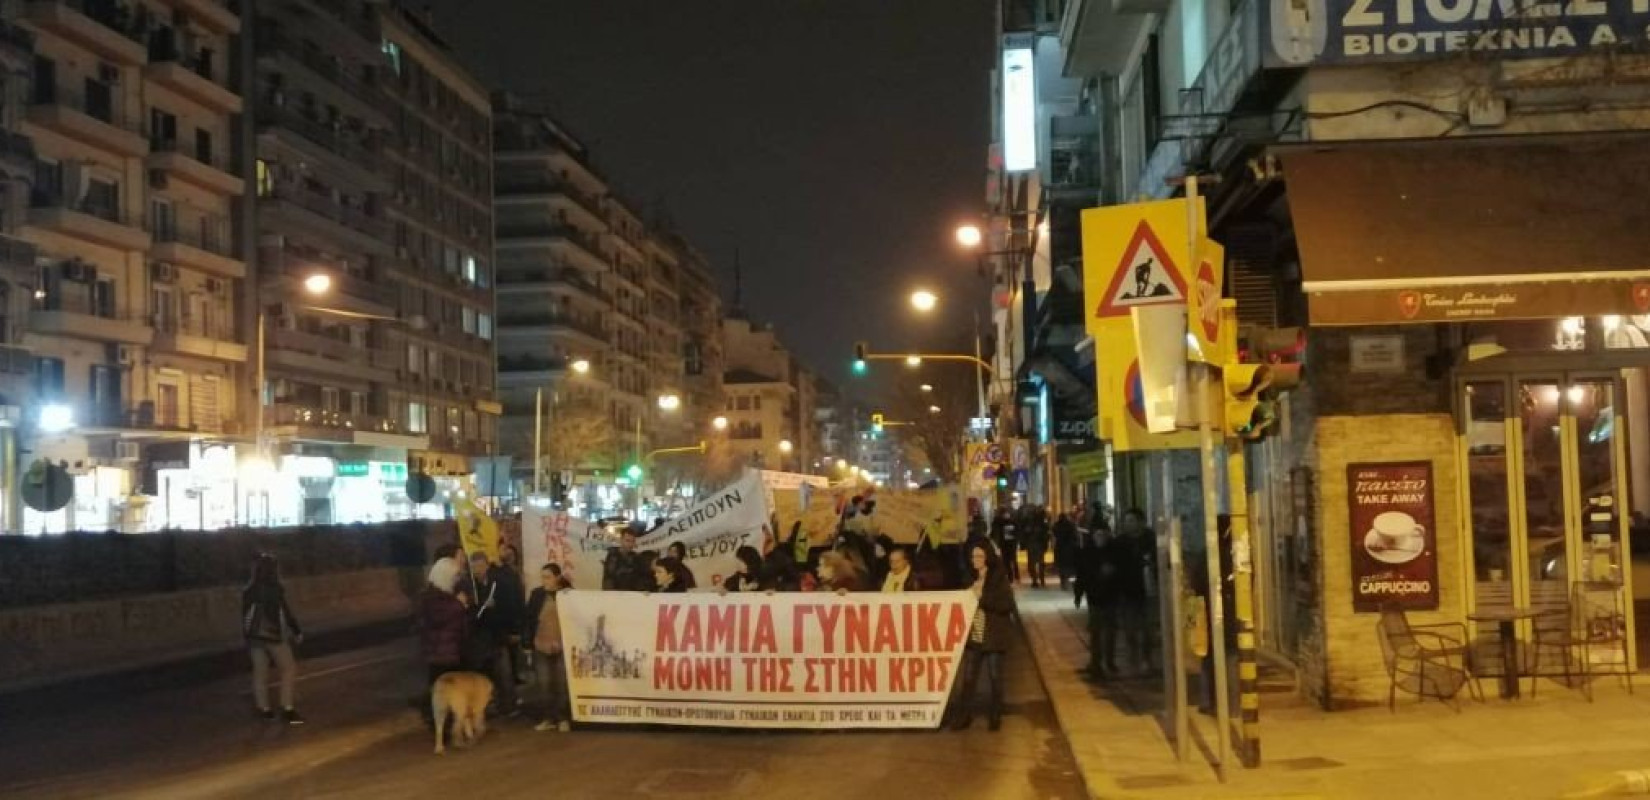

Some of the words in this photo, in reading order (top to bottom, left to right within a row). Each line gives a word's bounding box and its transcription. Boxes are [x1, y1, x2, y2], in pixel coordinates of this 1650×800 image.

[1343, 24, 1576, 56] ΒΙΟΤΕΧΝΙΑ
[667, 489, 743, 537] ΛΕΙΠΟΥΝ
[1356, 494, 1388, 504] TAKE
[1391, 494, 1425, 503] AWAY
[1359, 580, 1431, 594] CAPPUCCINO
[655, 603, 779, 653] ΚΑΜΙΑ
[793, 602, 967, 654] ΓΥΝΑΙΚΑ
[653, 656, 732, 692] ΜΟΝΗ
[742, 657, 795, 693] ΤΗΣ
[804, 657, 878, 693] ΣΤΗΝ
[889, 657, 953, 693] ΚΡΙΣ
[868, 708, 882, 721] ΚΑΙ
[885, 708, 897, 721] ΤΑ
